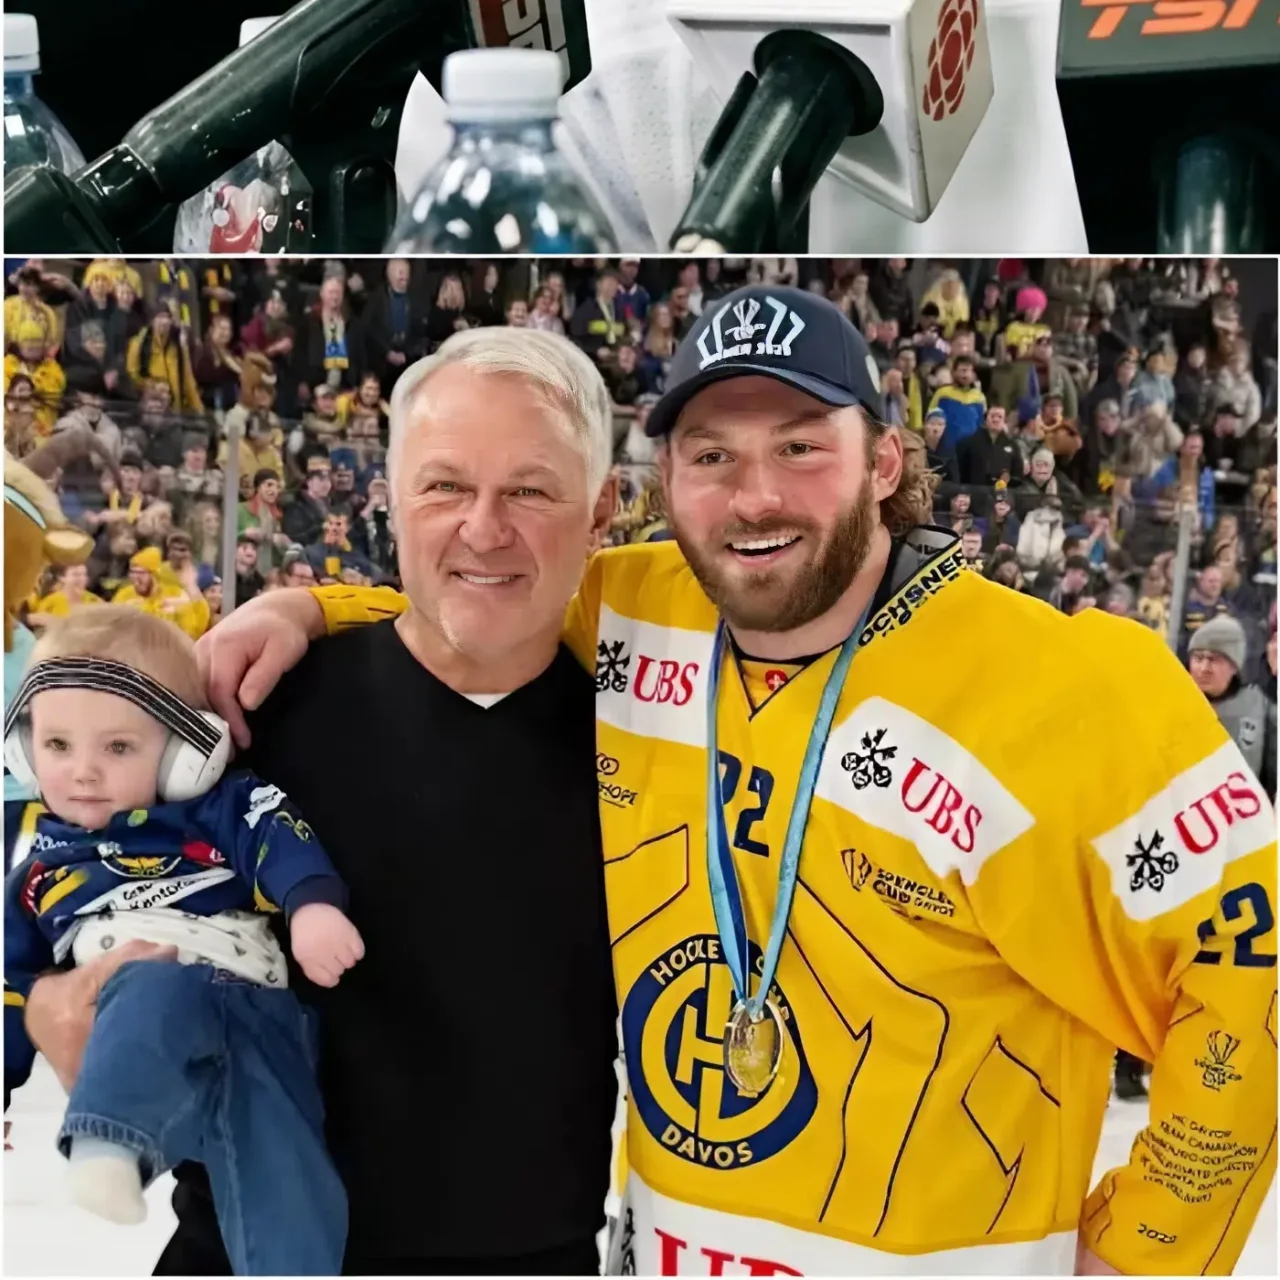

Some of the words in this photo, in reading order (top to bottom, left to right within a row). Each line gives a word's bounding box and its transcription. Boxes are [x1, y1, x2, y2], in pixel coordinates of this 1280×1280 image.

[633, 654, 699, 706] UBS
[901, 757, 982, 854] UBS
[661, 1124, 753, 1167] DAVOS
